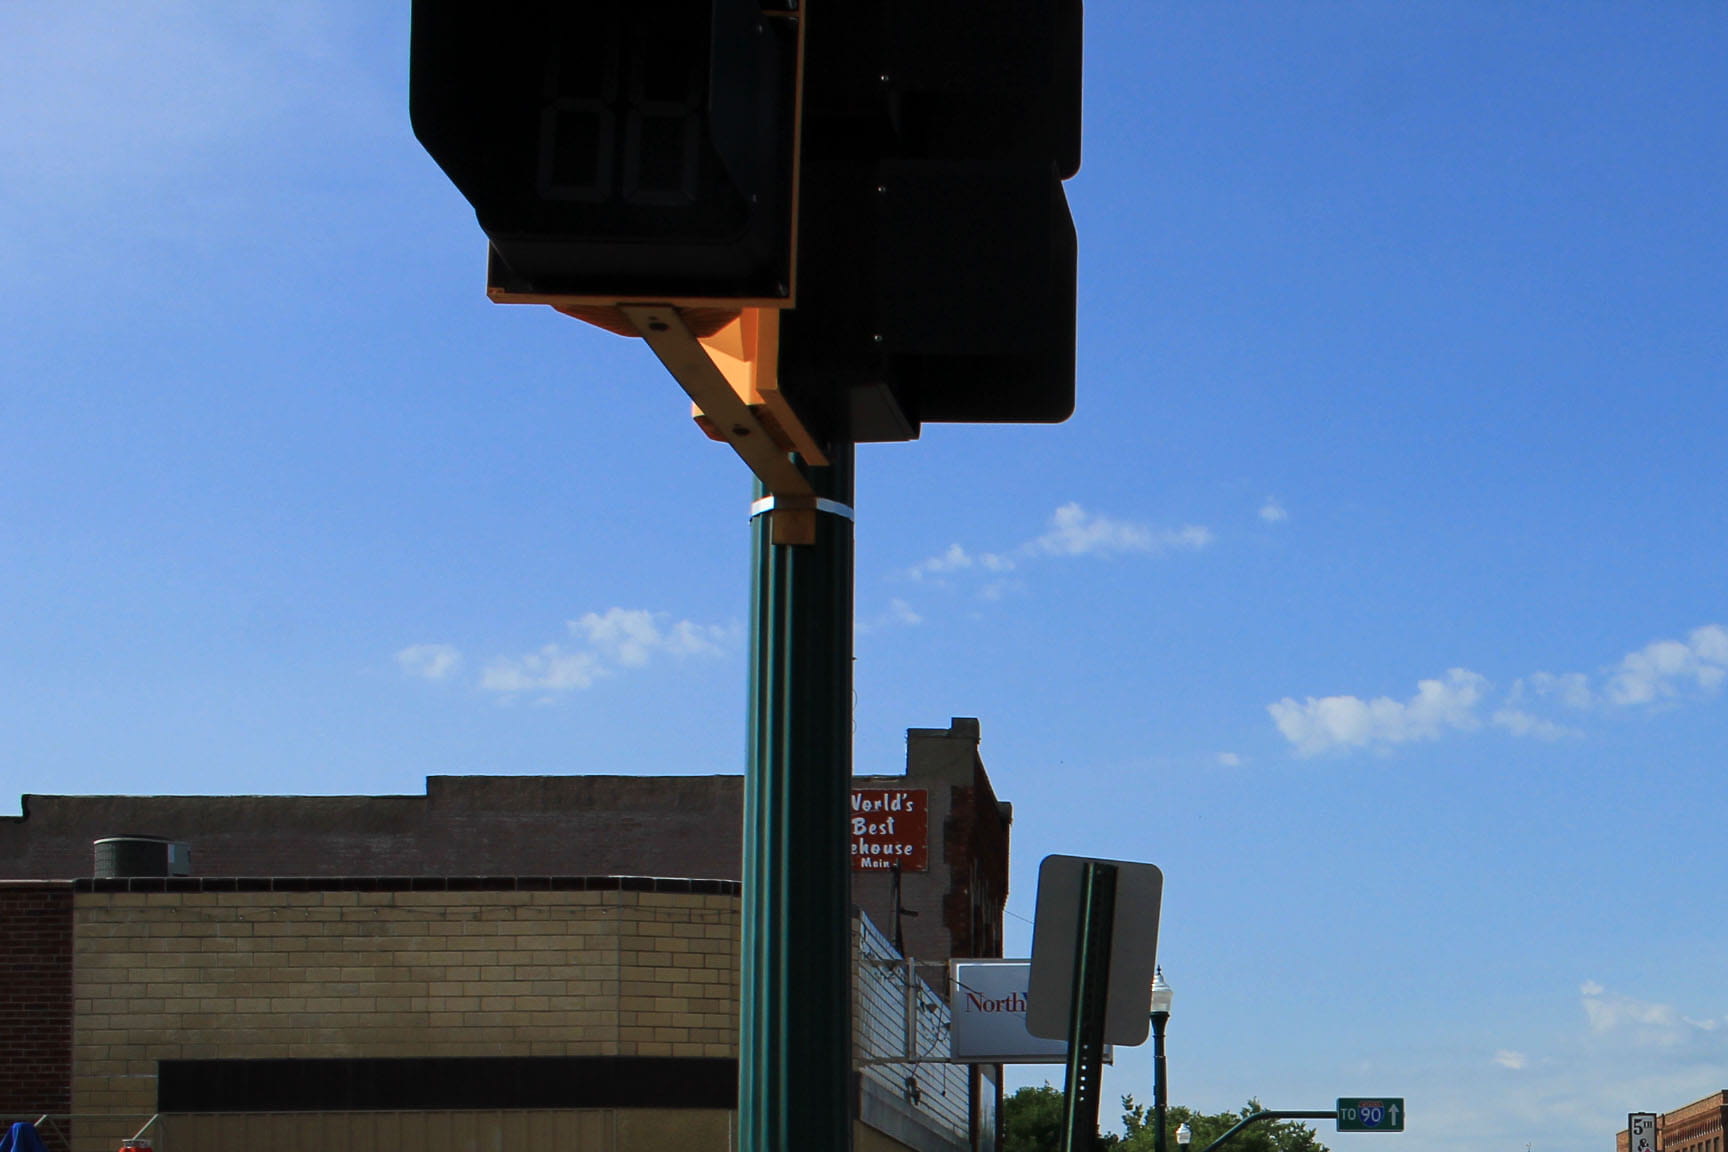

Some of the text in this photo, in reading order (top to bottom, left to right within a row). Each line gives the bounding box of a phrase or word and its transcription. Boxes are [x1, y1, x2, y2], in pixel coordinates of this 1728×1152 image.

[851, 817, 895, 835] Best
[861, 857, 890, 868] Main
[965, 992, 1028, 1012] North
[1341, 1107, 1381, 1122] TO 90
